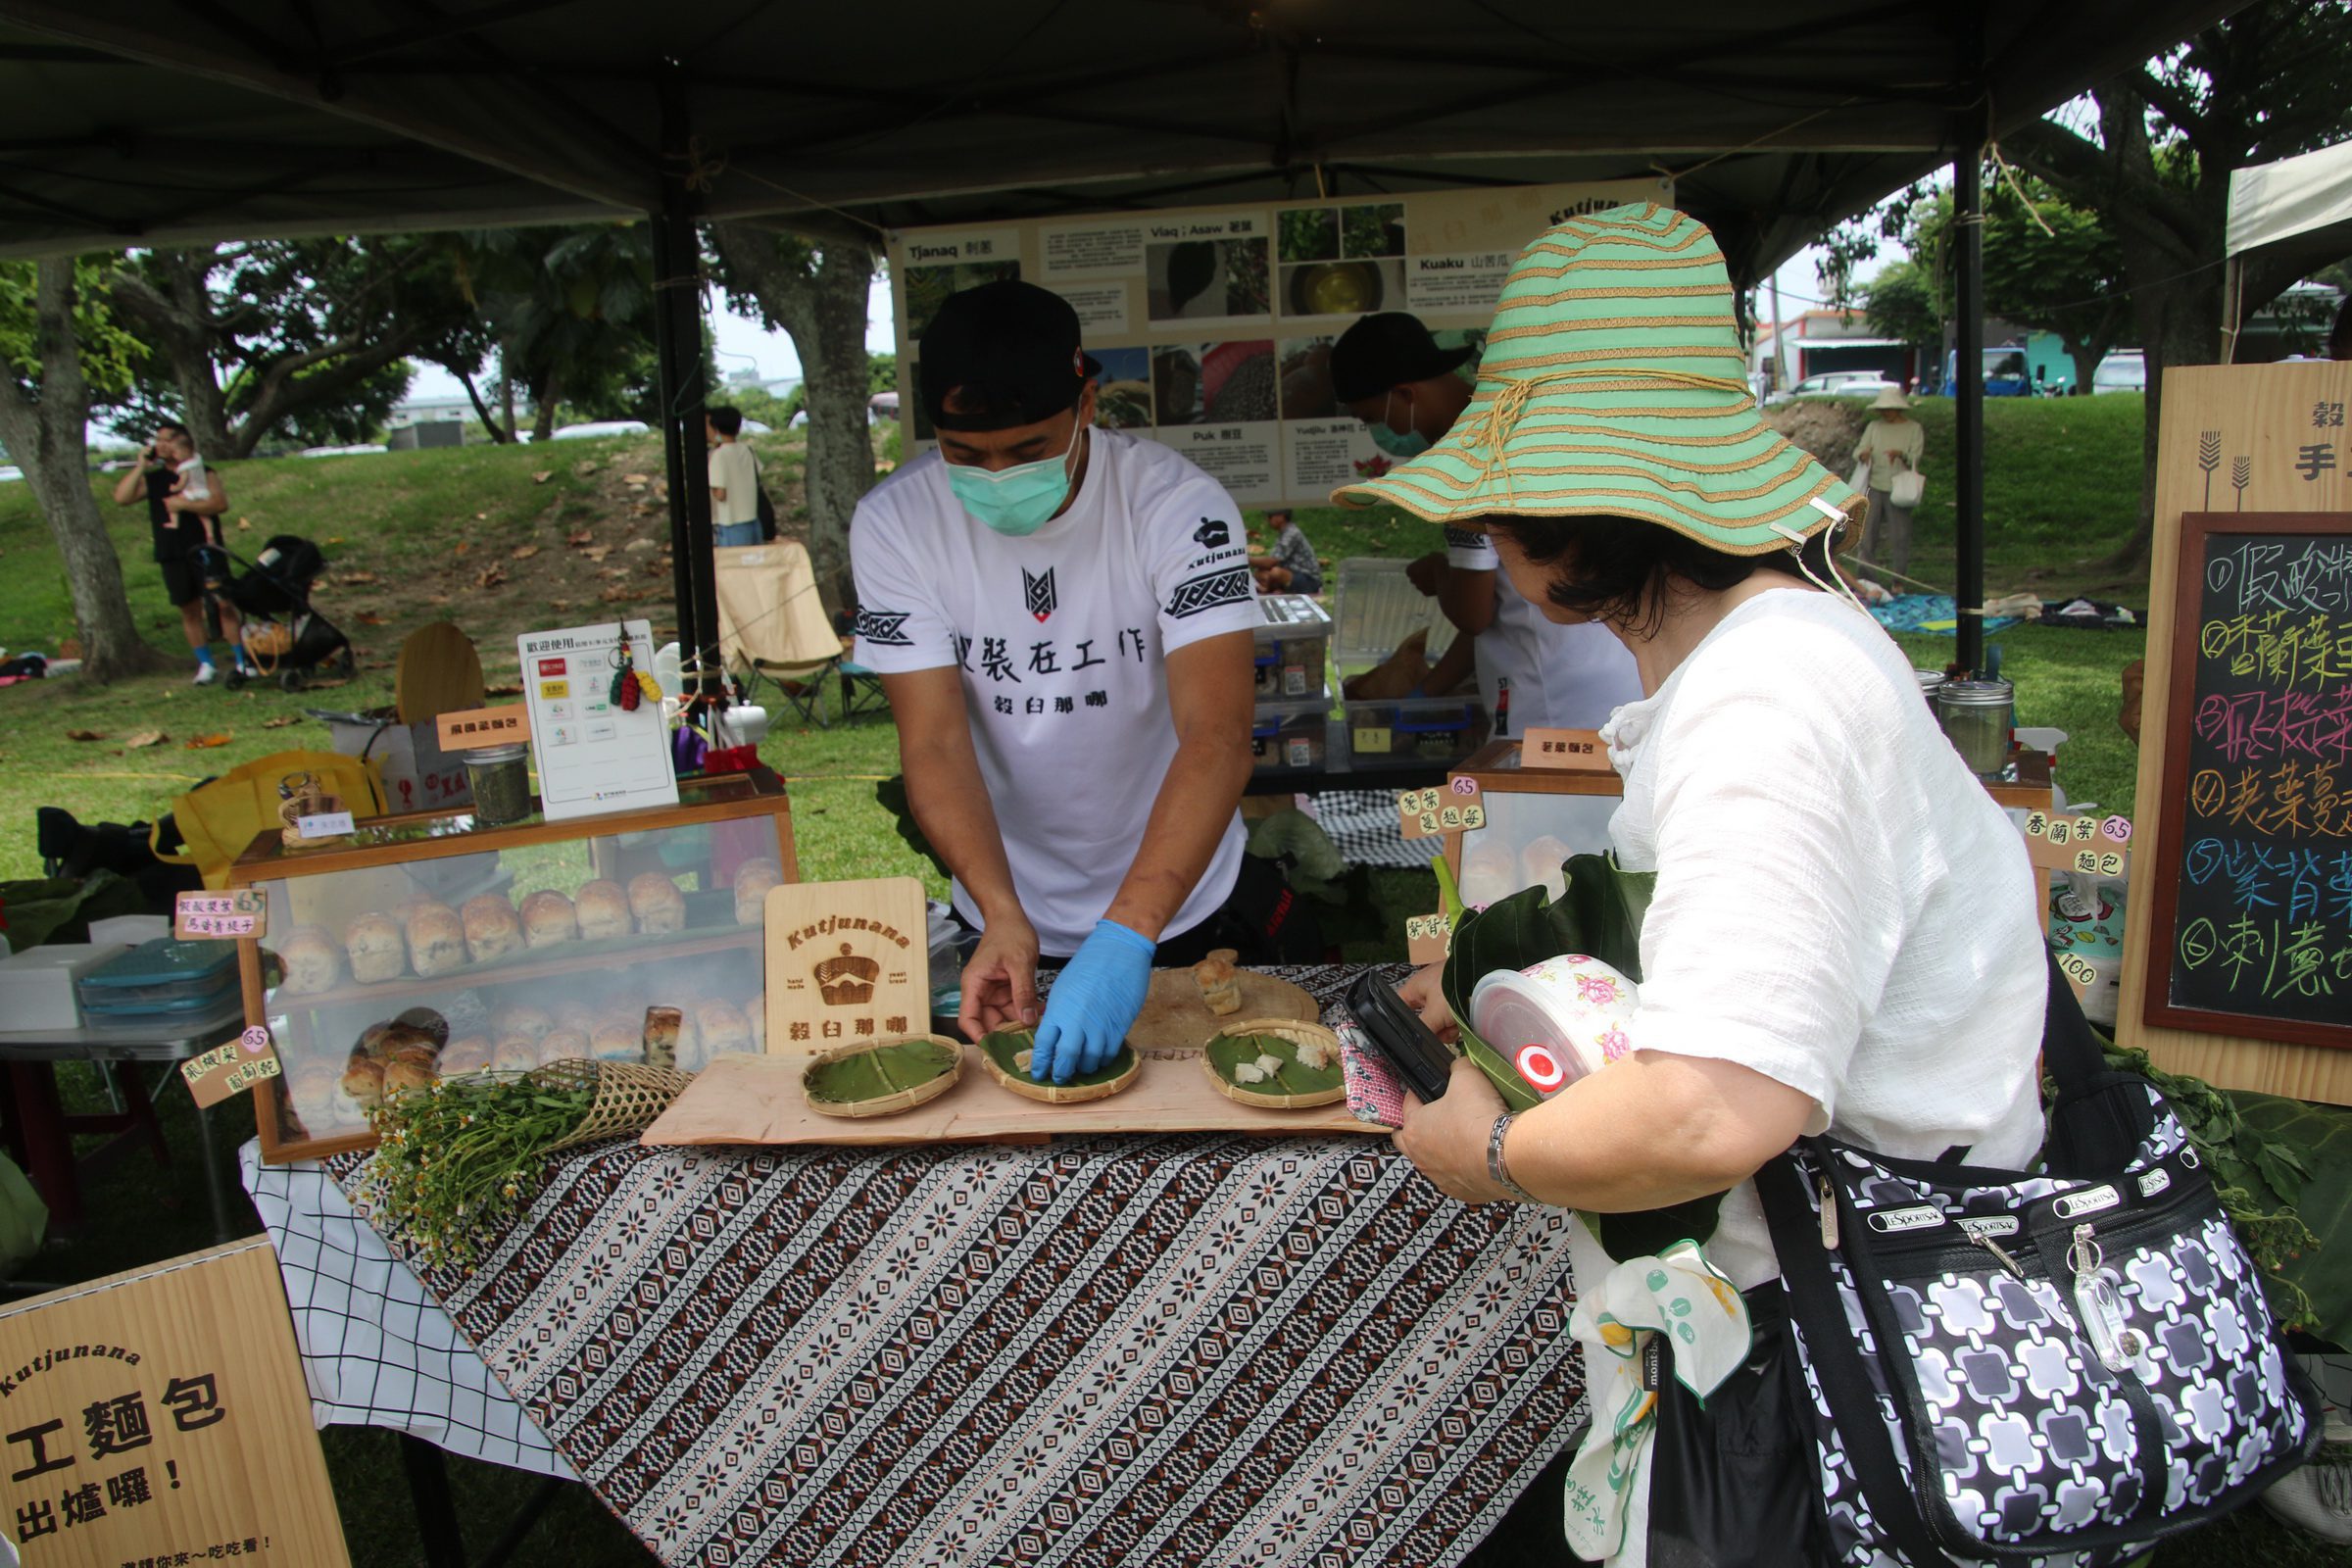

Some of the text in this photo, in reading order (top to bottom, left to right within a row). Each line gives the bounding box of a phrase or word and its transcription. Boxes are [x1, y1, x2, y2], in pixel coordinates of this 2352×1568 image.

[909, 244, 958, 261] Tjanaq
[1420, 253, 1509, 270] Kuaku 山苦瓜
[1193, 429, 1216, 441] Puk
[1453, 779, 1474, 795] 65
[2026, 814, 2130, 844] 香蘭葉 65
[2078, 852, 2118, 875] 麵包
[237, 891, 266, 912] 65
[787, 914, 910, 952] Kutjunana
[2061, 953, 2095, 983] 100
[243, 1030, 266, 1046] 65
[790, 1016, 907, 1041] 穀臼那哪
[0, 1344, 142, 1398] Kutjunana
[6, 1373, 226, 1483] 工麵包
